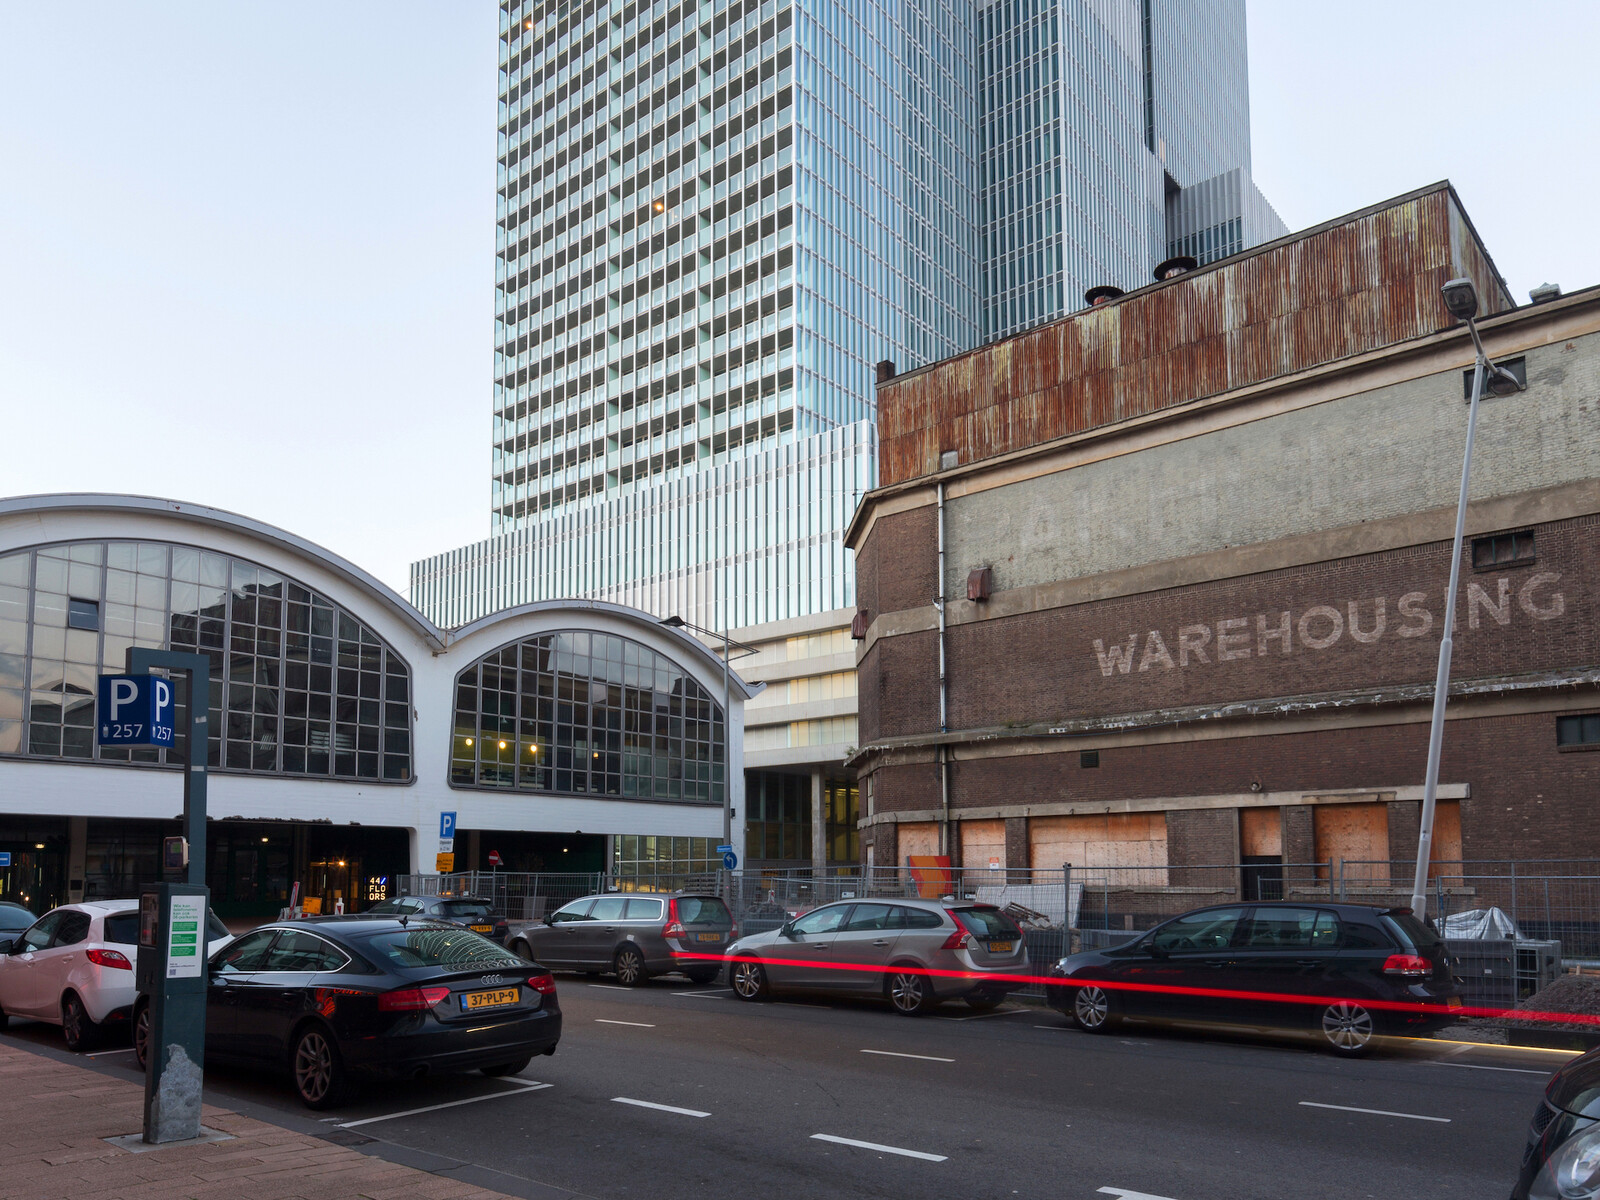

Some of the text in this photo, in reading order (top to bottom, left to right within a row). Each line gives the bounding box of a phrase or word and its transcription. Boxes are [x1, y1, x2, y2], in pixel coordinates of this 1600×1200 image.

[110, 678, 139, 721] P
[155, 680, 170, 723] P
[112, 724, 143, 738] 257
[156, 725, 172, 741] 257
[442, 815, 452, 835] P
[369, 885, 386, 893] FLO
[369, 892, 386, 901] ORS
[471, 990, 515, 1006] 37-PLP-9
